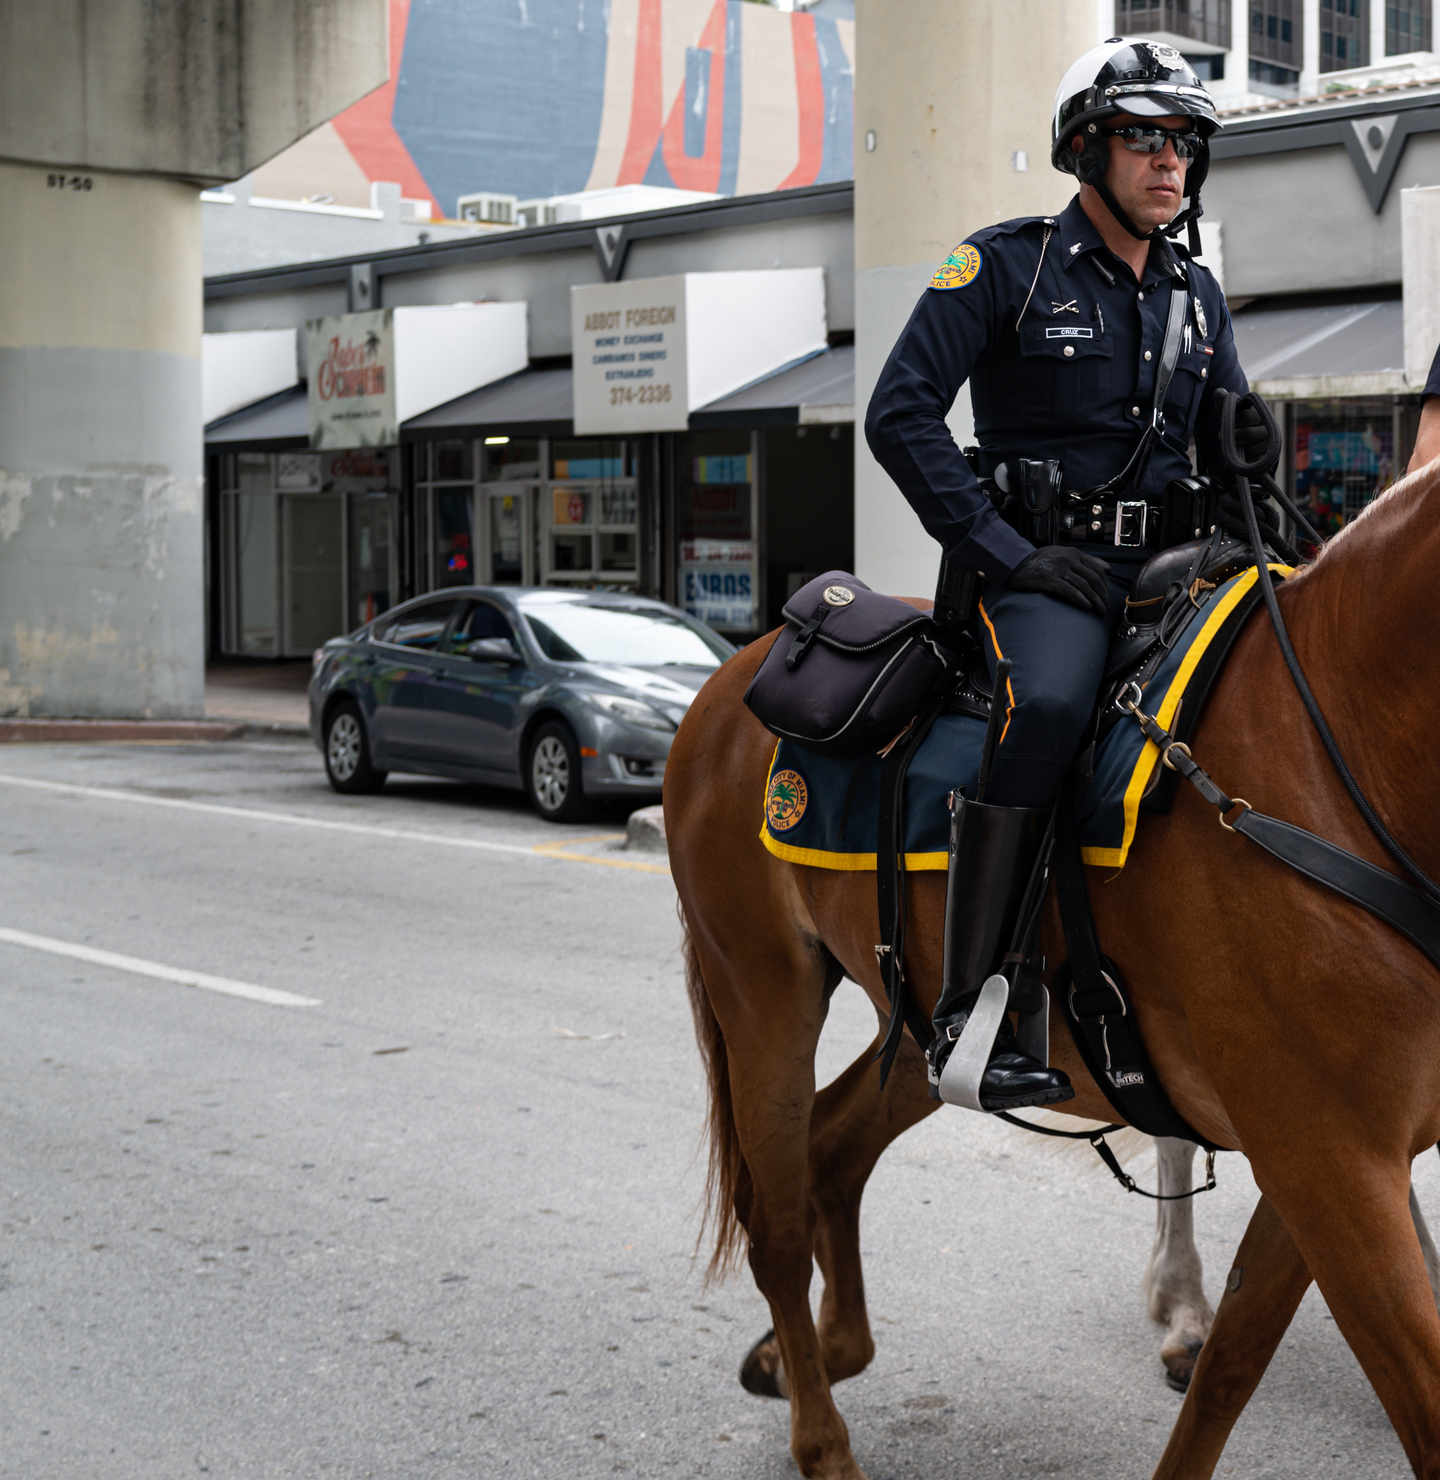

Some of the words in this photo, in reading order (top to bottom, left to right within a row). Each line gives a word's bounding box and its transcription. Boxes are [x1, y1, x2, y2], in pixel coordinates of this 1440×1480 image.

[968, 250, 978, 274] MIAMI
[584, 311, 621, 331] ABBOT
[625, 306, 675, 328] FOREIGN
[595, 336, 620, 347] MONEY
[624, 332, 663, 346] EXCHANGE
[592, 352, 635, 365] CAMBIAMOS
[639, 350, 667, 362] DINERO
[605, 368, 654, 381] EXTRANJERO
[609, 383, 672, 406] 374-2336
[692, 488, 738, 512] ABBOT
[686, 573, 751, 602] EUROS
[774, 772, 787, 783] CITY
[787, 771, 797, 780] OF
[796, 779, 806, 805] MIAMI
[770, 816, 791, 828] POLICE
